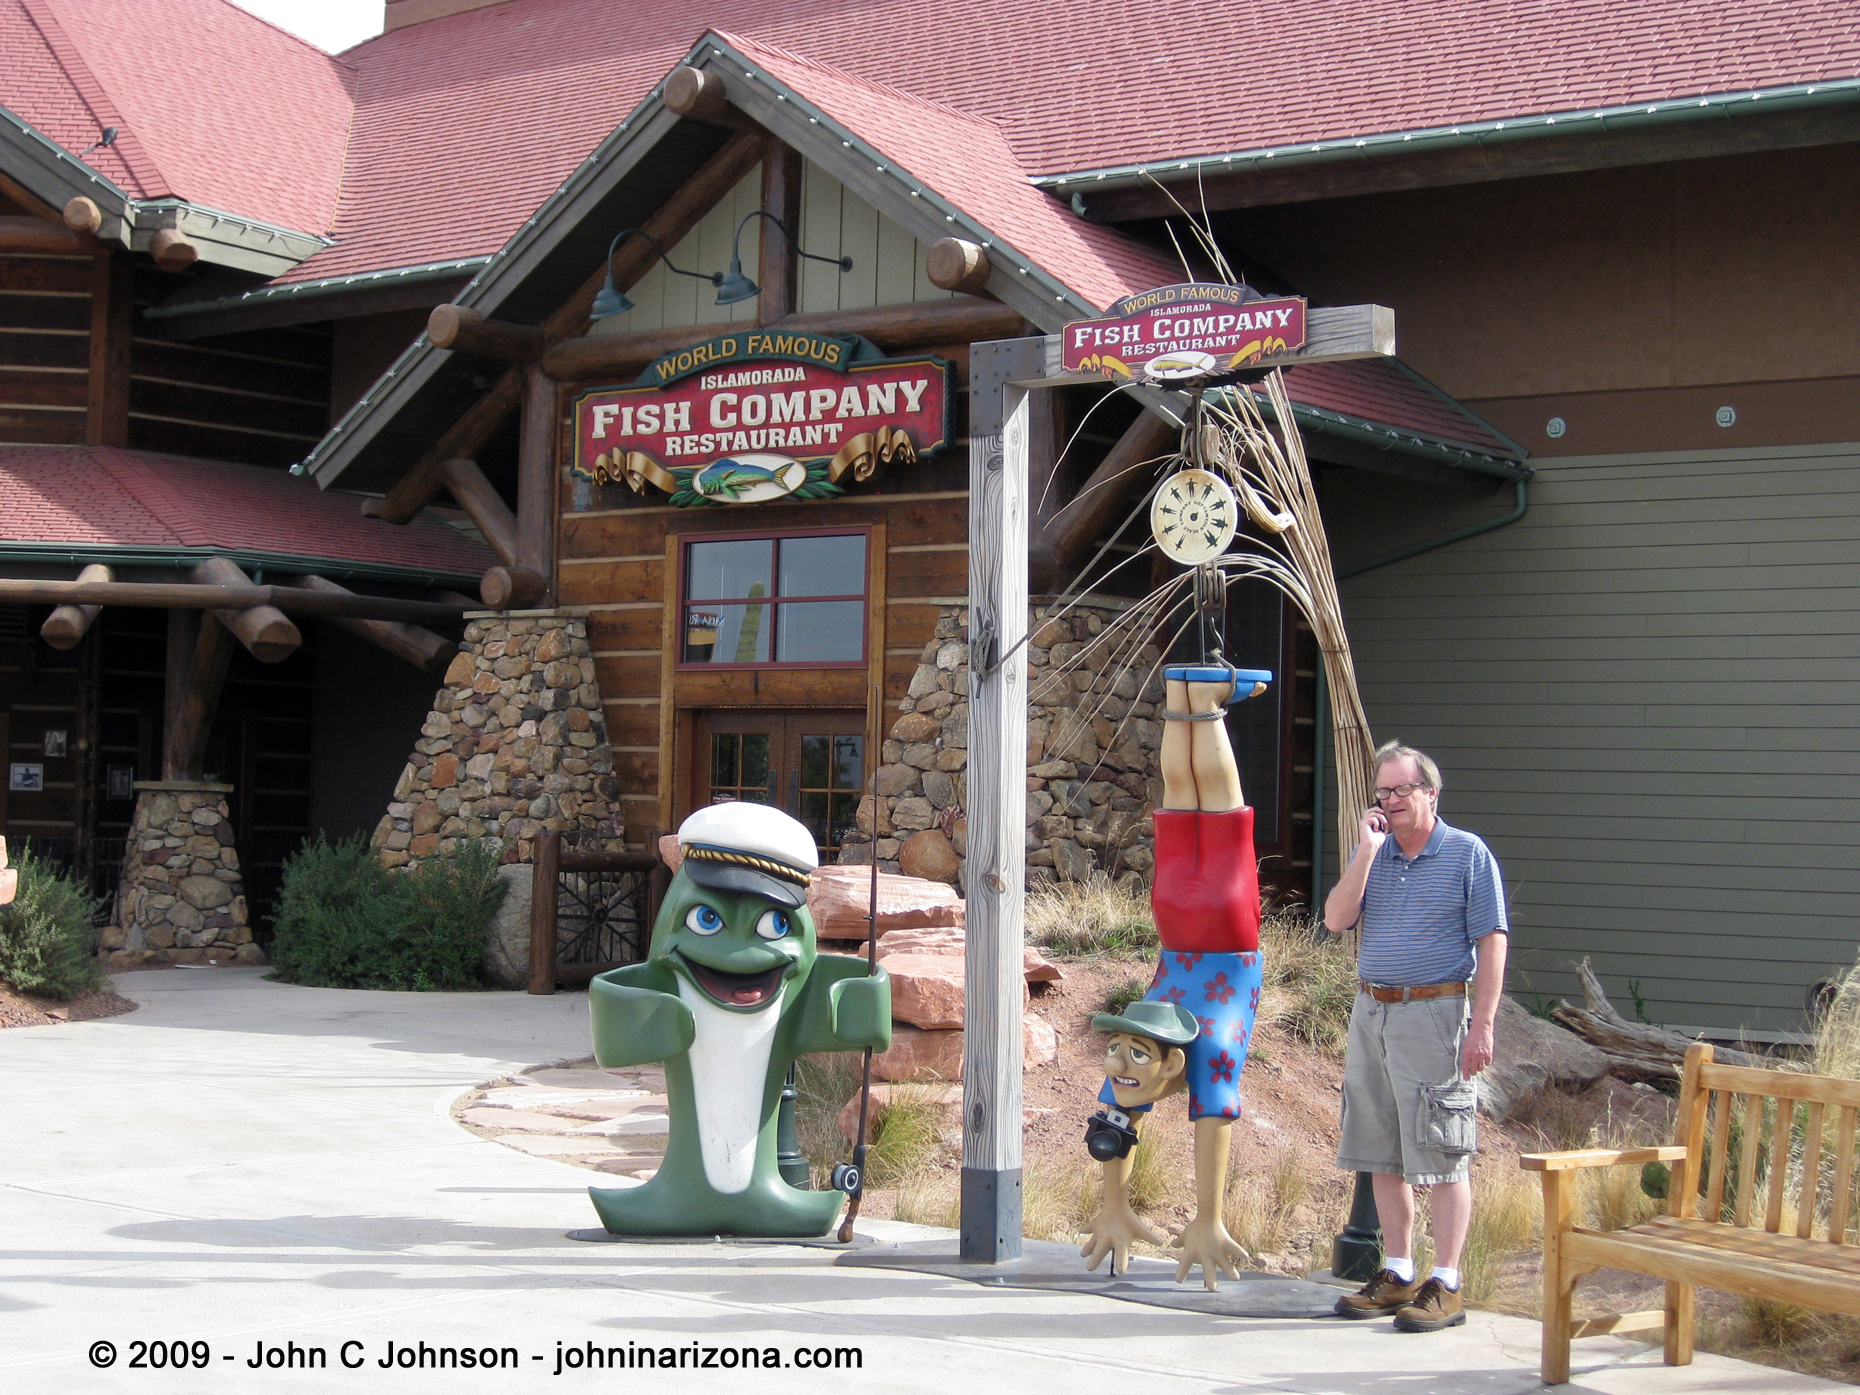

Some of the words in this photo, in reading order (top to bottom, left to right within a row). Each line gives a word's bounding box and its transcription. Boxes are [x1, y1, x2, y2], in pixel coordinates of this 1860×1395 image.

[1123, 289, 1176, 315] WORLD
[1180, 287, 1240, 303] FAMOUS
[1150, 303, 1212, 317] ISLAMORADA
[1074, 324, 1141, 349] FISH
[1153, 308, 1294, 340] COMPANY
[655, 337, 738, 381] WORLD
[747, 335, 842, 365] FAMOUS
[1121, 335, 1240, 357] RESTAURANT
[700, 366, 806, 391] ISLAMORADA
[591, 401, 692, 439] FISH
[709, 379, 929, 429] COMPANY
[665, 422, 843, 456] RESTAURANT
